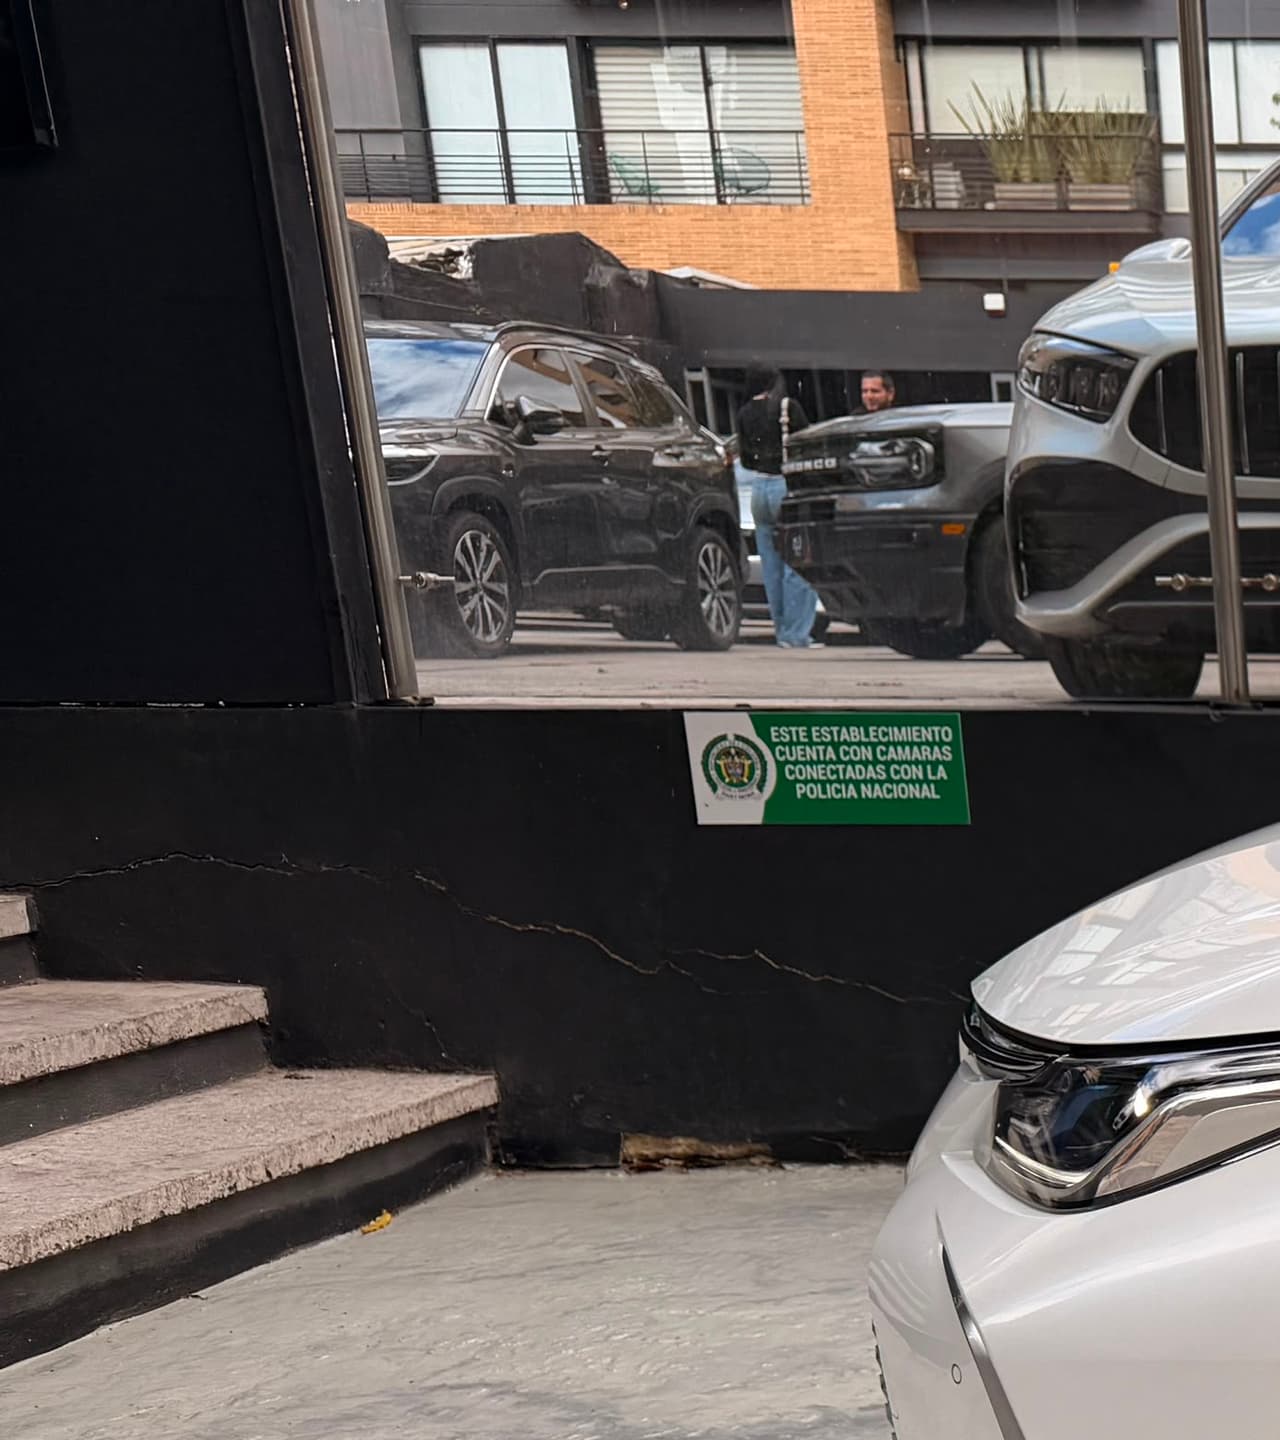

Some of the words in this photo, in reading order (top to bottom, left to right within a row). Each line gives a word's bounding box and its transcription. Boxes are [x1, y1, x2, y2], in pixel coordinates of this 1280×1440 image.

[770, 726, 808, 742] ESTE
[812, 726, 953, 742] ESTABLECIMIENTO
[775, 745, 835, 761] CUENTA
[839, 745, 873, 761] CON
[876, 745, 953, 761] CAMARAS
[785, 764, 887, 780] CONECTADAS
[890, 764, 923, 780] CON
[927, 764, 948, 780] LA
[796, 783, 857, 799] POLICIA
[860, 783, 941, 799] NACIONAL
